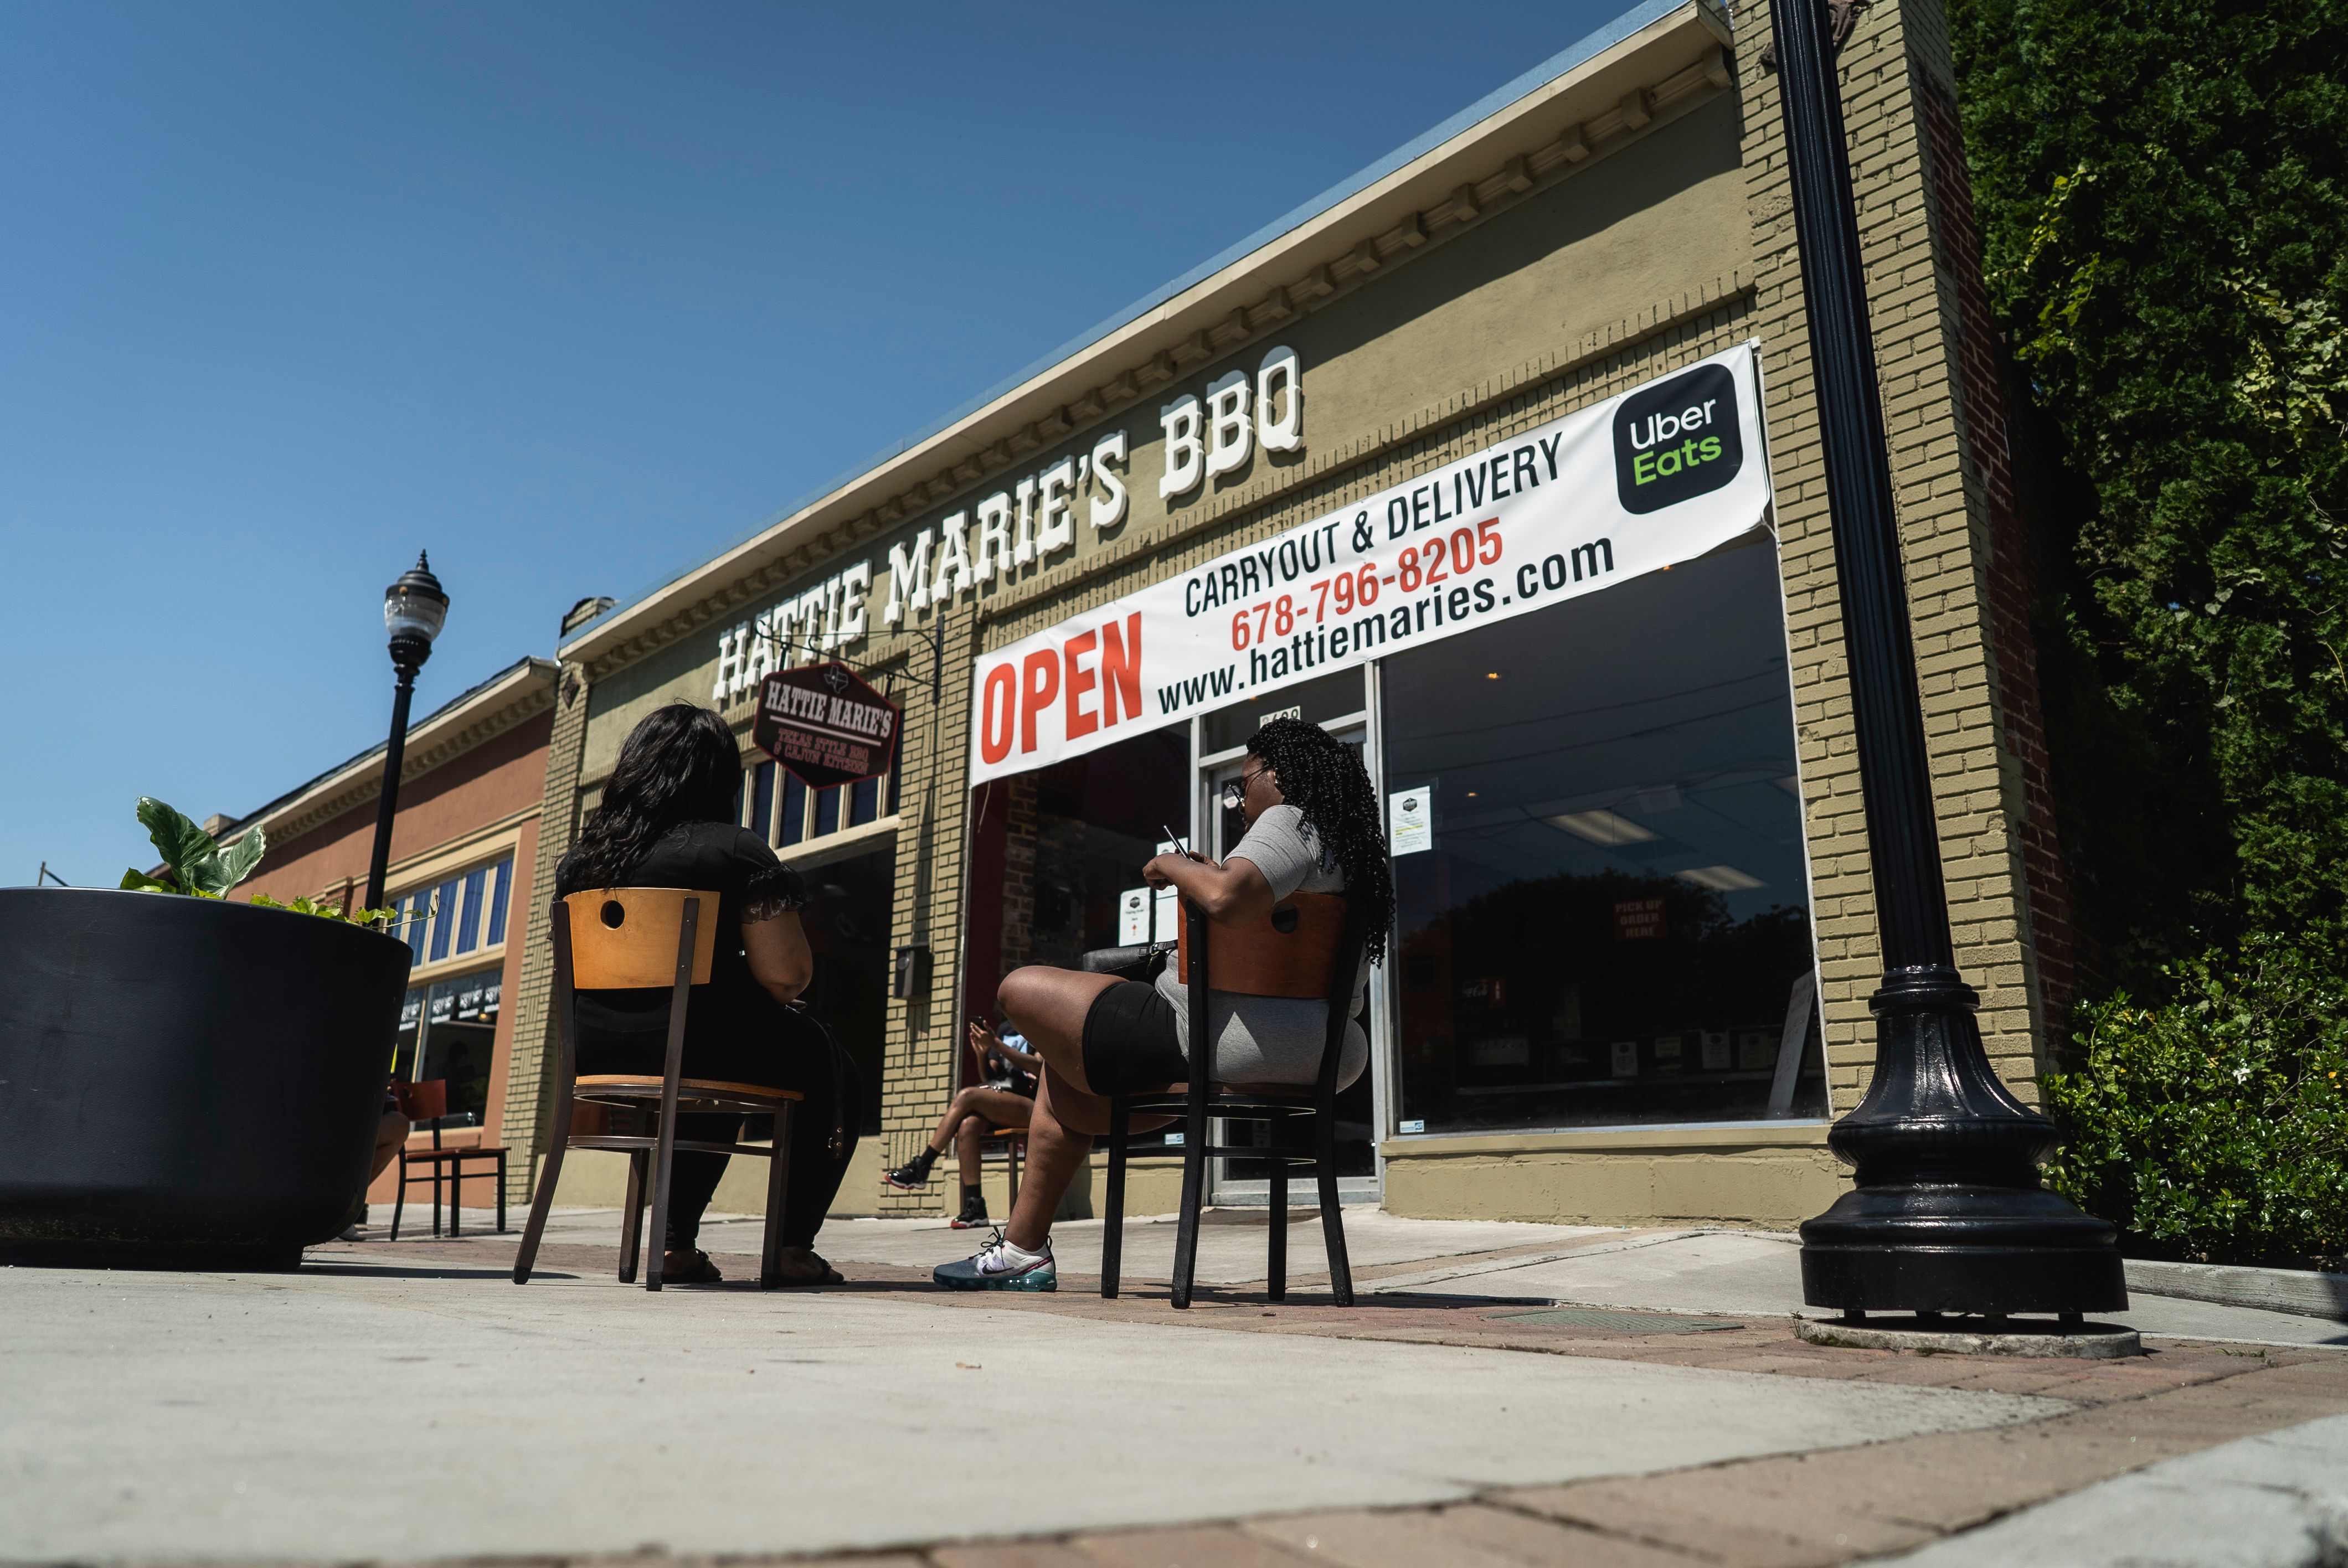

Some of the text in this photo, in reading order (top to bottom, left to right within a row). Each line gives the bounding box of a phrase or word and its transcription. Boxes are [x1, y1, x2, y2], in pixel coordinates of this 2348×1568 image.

[1630, 399, 1716, 450] Uber
[1634, 436, 1721, 486] Eats
[712, 345, 1303, 700] HATTIE MARIE'S BBQ
[1186, 431, 1562, 617] CARRYOUT & DELIVERY
[1232, 517, 1502, 651] 678-796-8205
[1158, 538, 1614, 714] www.hattiemaries.com
[765, 680, 893, 738] HATTIE MARIE'S
[981, 611, 1142, 765] OPEN
[779, 728, 869, 762] TEXAS STYLE BBQ
[785, 745, 821, 764] CAJUN
[823, 754, 869, 775] KITCHEN
[1615, 899, 1662, 913] PICK UP
[1620, 912, 1660, 925] ORDER
[1626, 925, 1656, 937] HERE
